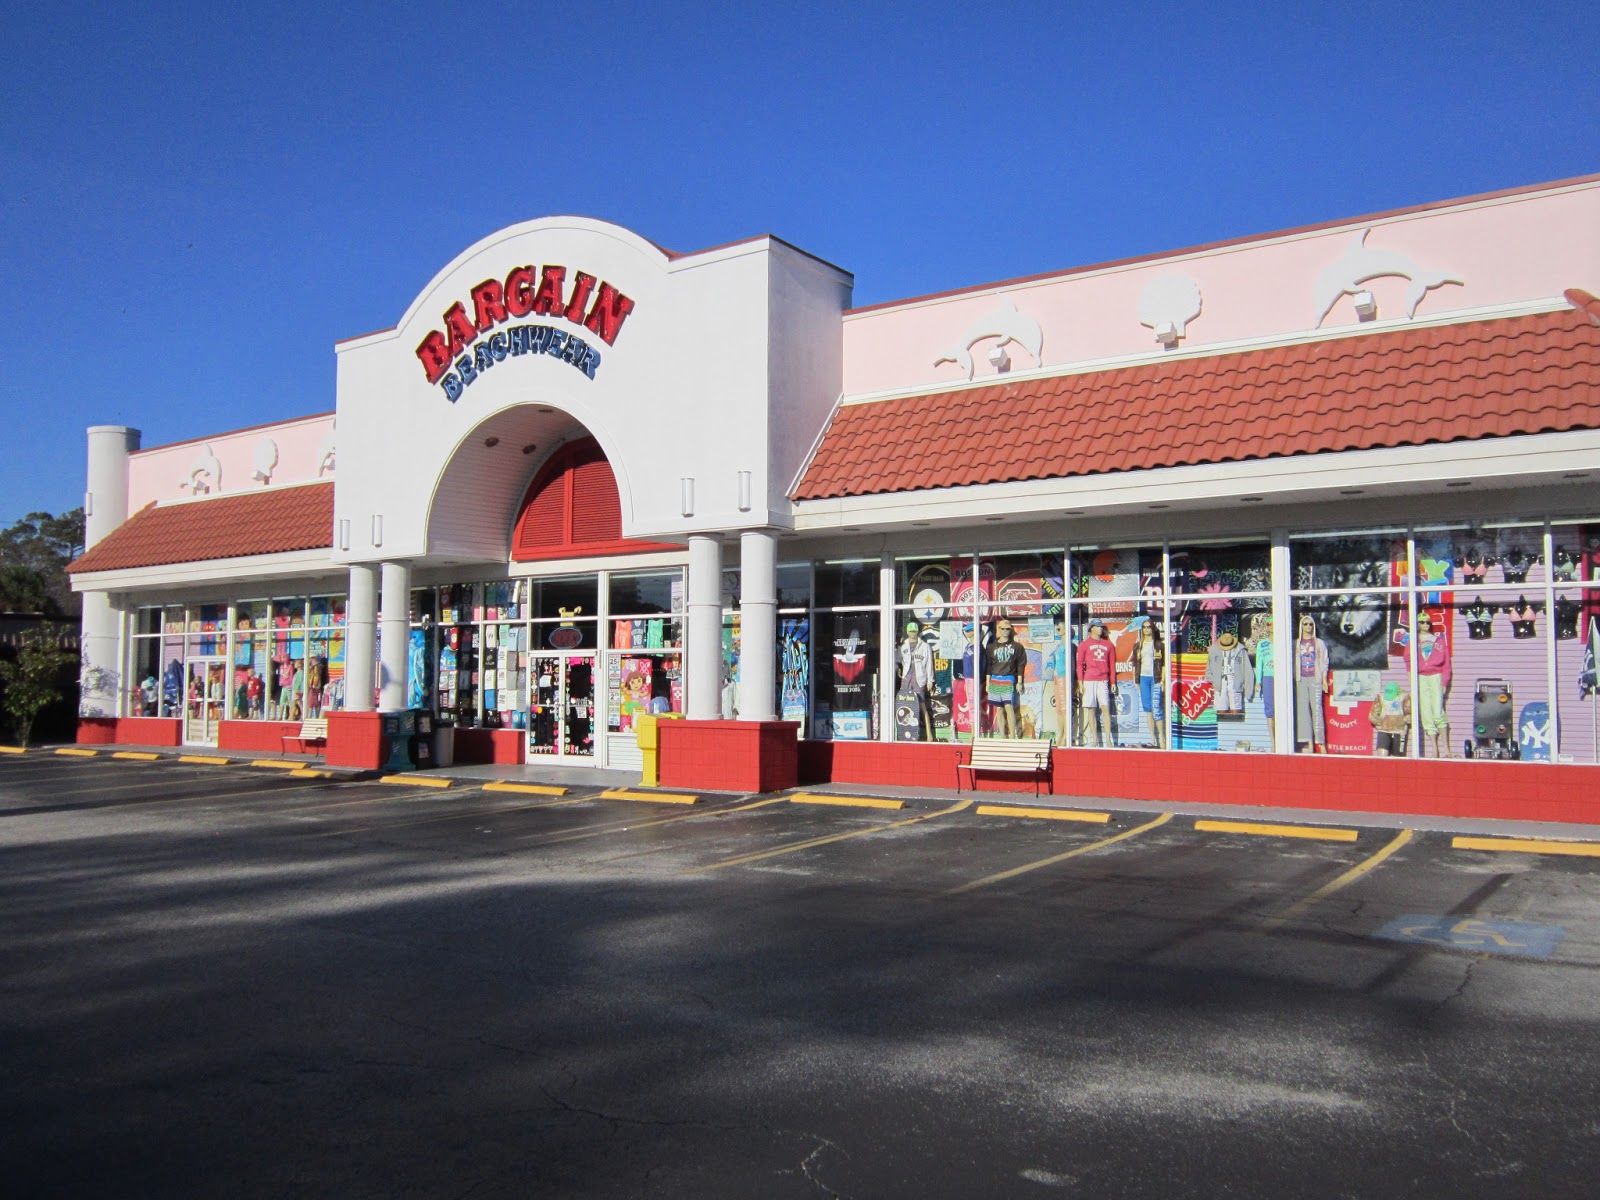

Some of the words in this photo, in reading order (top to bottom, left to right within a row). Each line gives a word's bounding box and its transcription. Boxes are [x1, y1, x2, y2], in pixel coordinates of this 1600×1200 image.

[415, 264, 635, 386] BARGAIN
[440, 324, 601, 403] BEACHWEAR
[955, 568, 991, 577] BOSON
[960, 589, 987, 602] BOSON
[1329, 718, 1340, 728] ON
[1340, 719, 1358, 729] DUTY
[1327, 743, 1344, 751] RTLE
